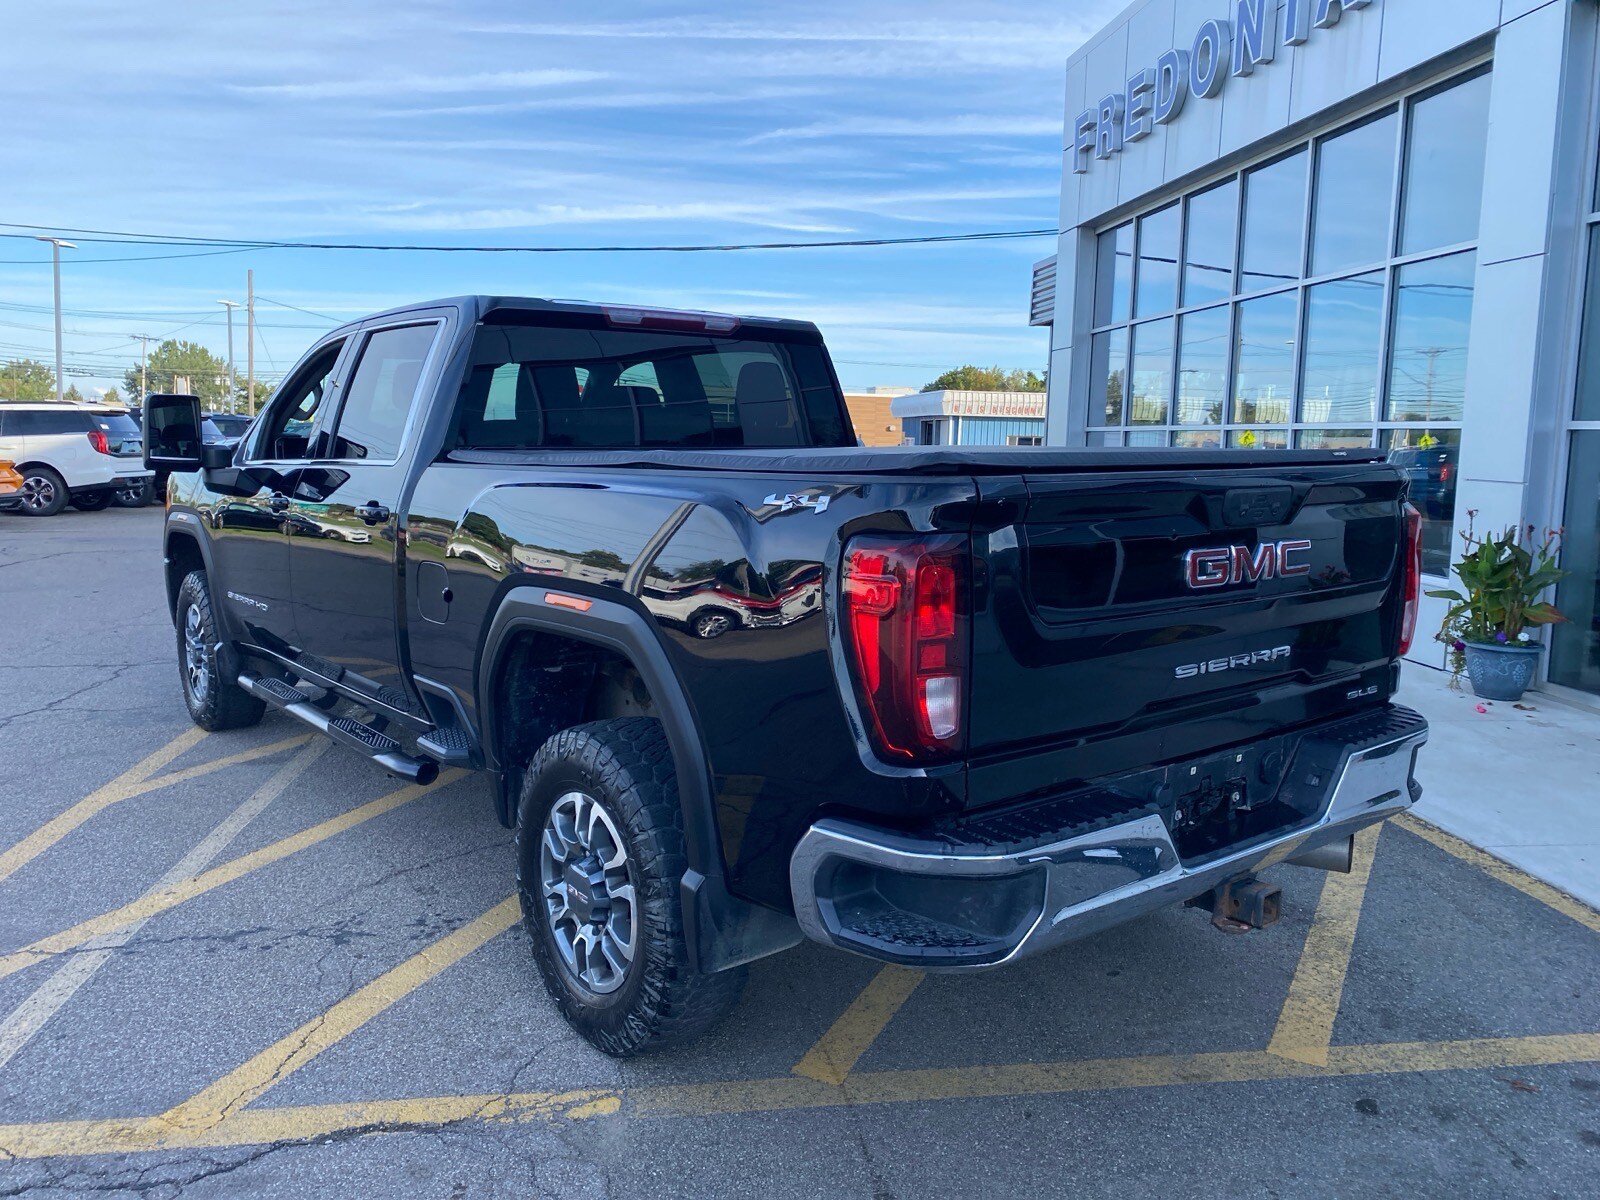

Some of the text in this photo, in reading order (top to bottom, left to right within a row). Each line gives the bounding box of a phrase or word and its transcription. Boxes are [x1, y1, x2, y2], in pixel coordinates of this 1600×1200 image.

[1073, 0, 1372, 174] FREDONI
[1186, 539, 1312, 589] GMC
[1174, 644, 1291, 679] SIERRA
[1346, 685, 1378, 699] SLE
